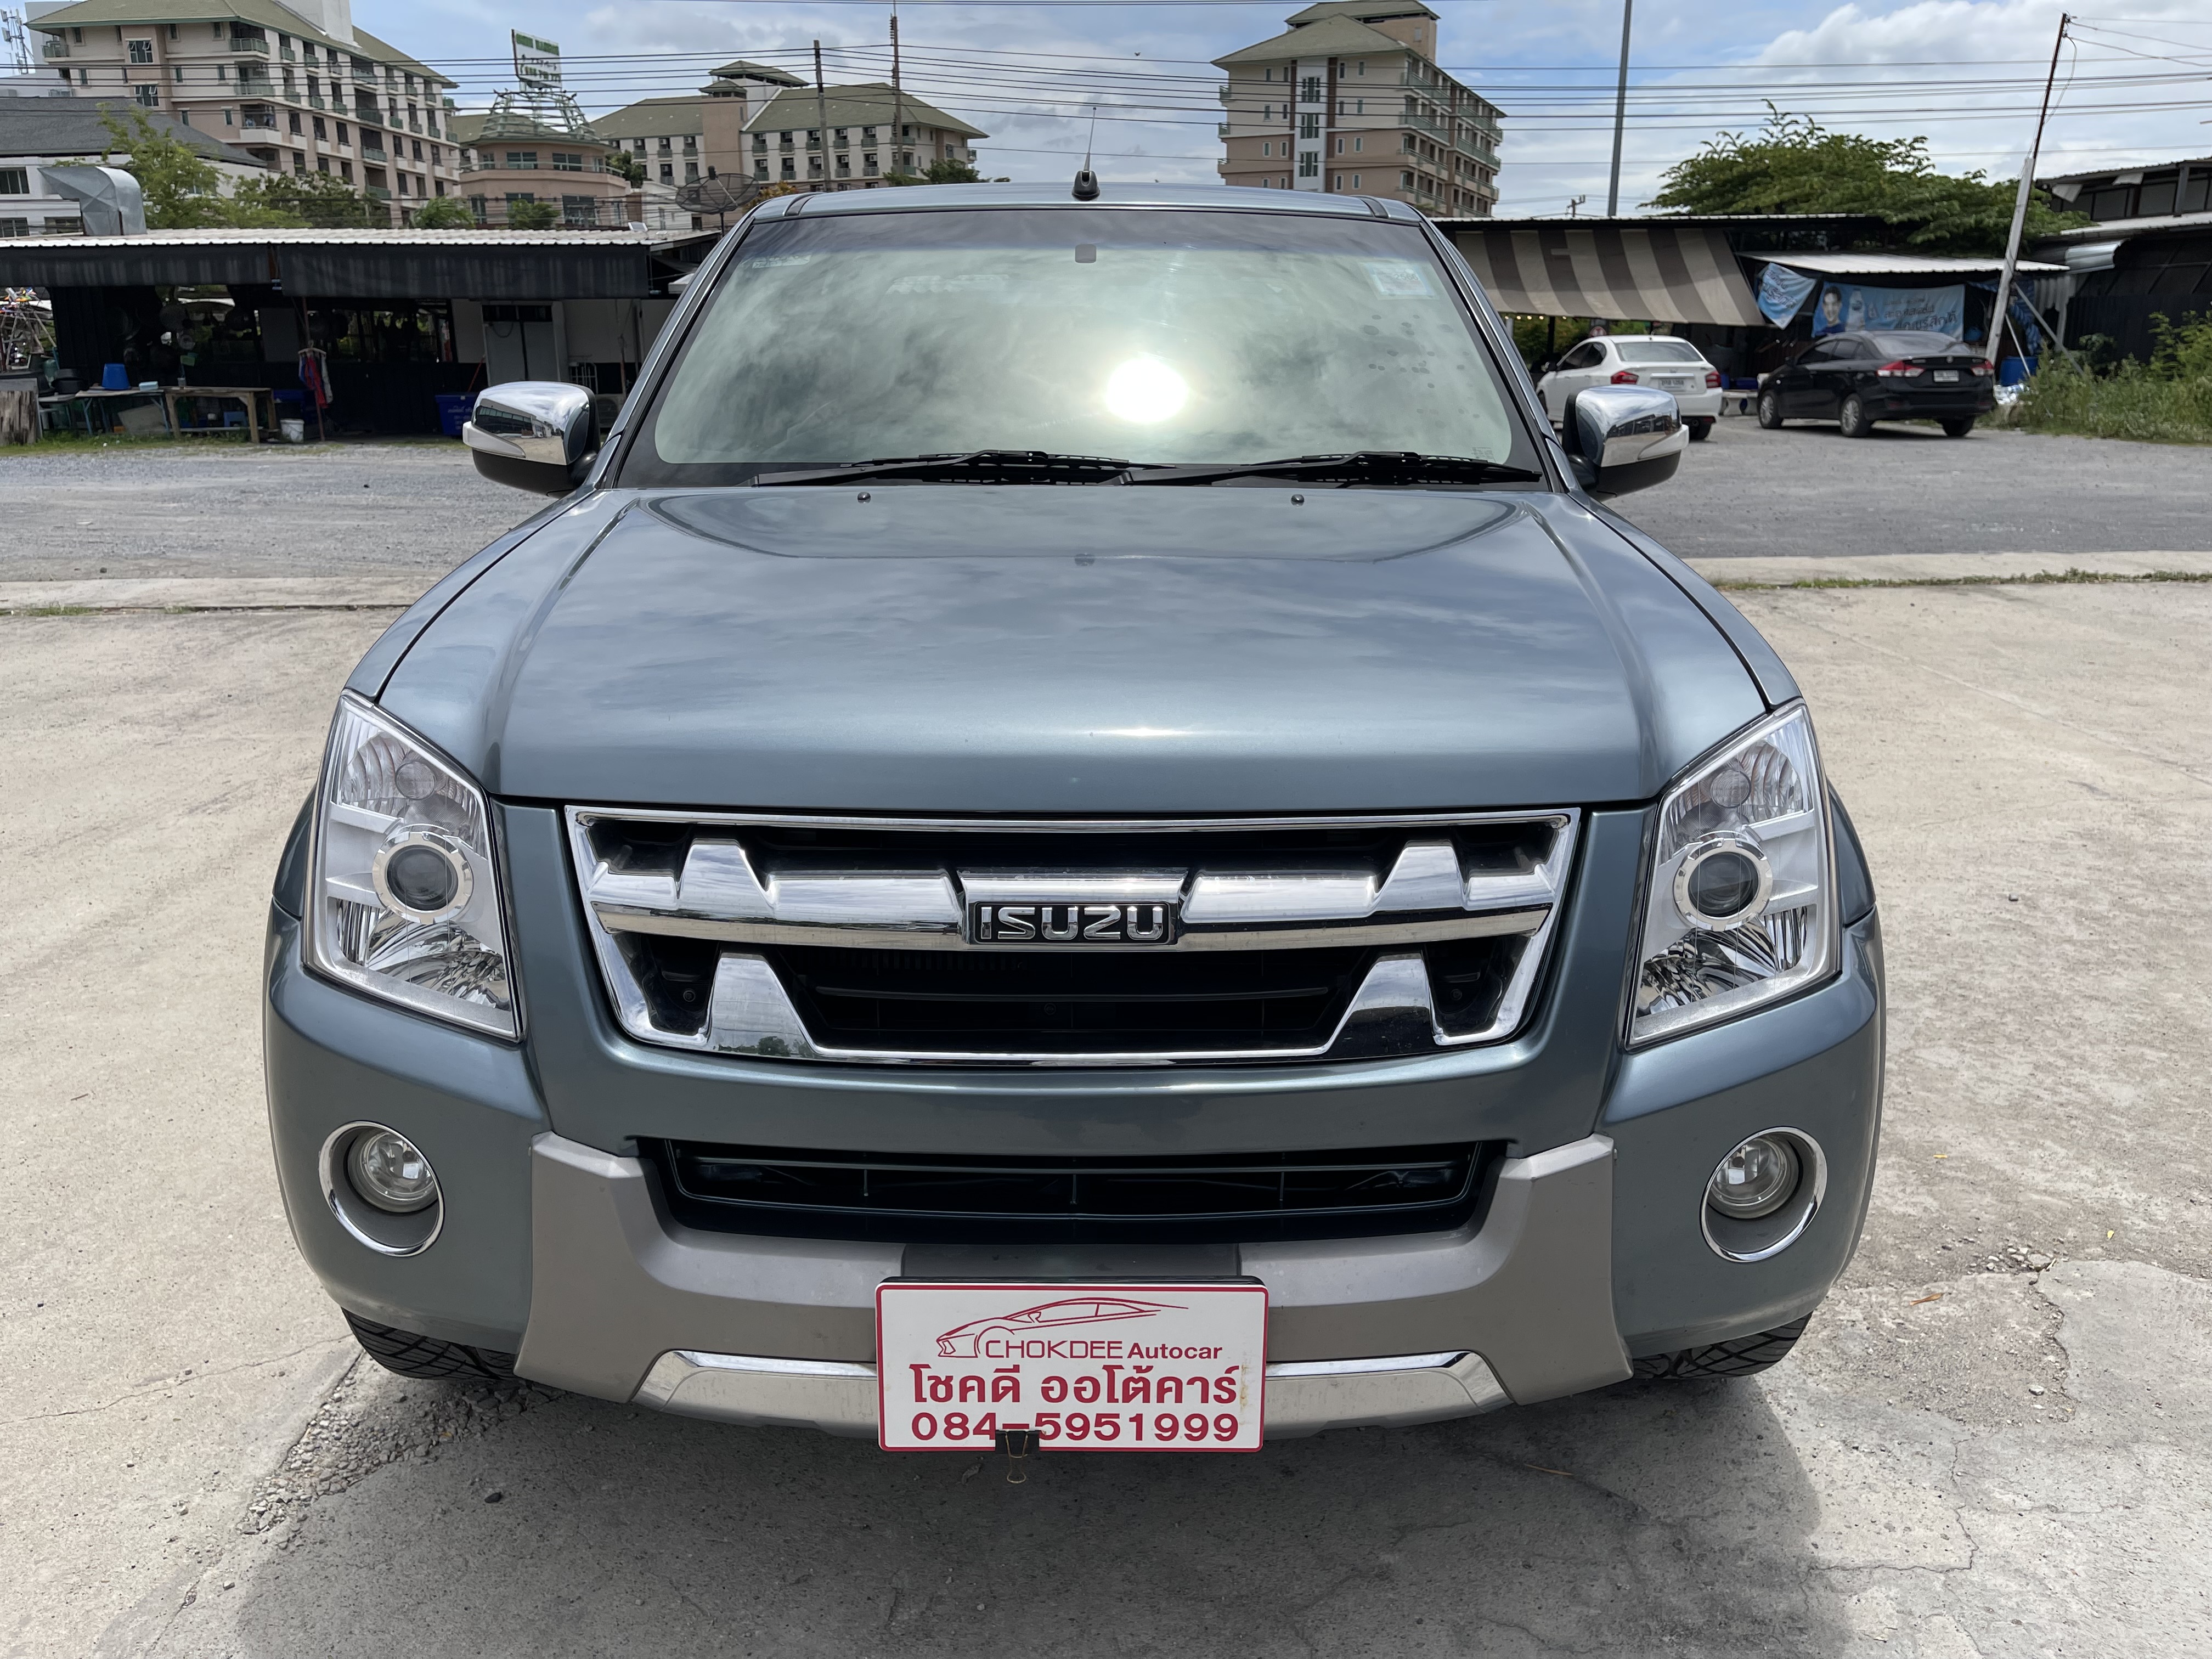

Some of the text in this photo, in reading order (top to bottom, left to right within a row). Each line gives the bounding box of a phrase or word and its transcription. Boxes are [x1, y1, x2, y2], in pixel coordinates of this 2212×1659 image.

[980, 906, 1164, 940] ISUZU
[985, 1340, 1223, 1359] CHOKDEE Autocar
[909, 1363, 1240, 1404] โชคดี ออโต้คาร์
[911, 1412, 1238, 1442] 084-5951999
